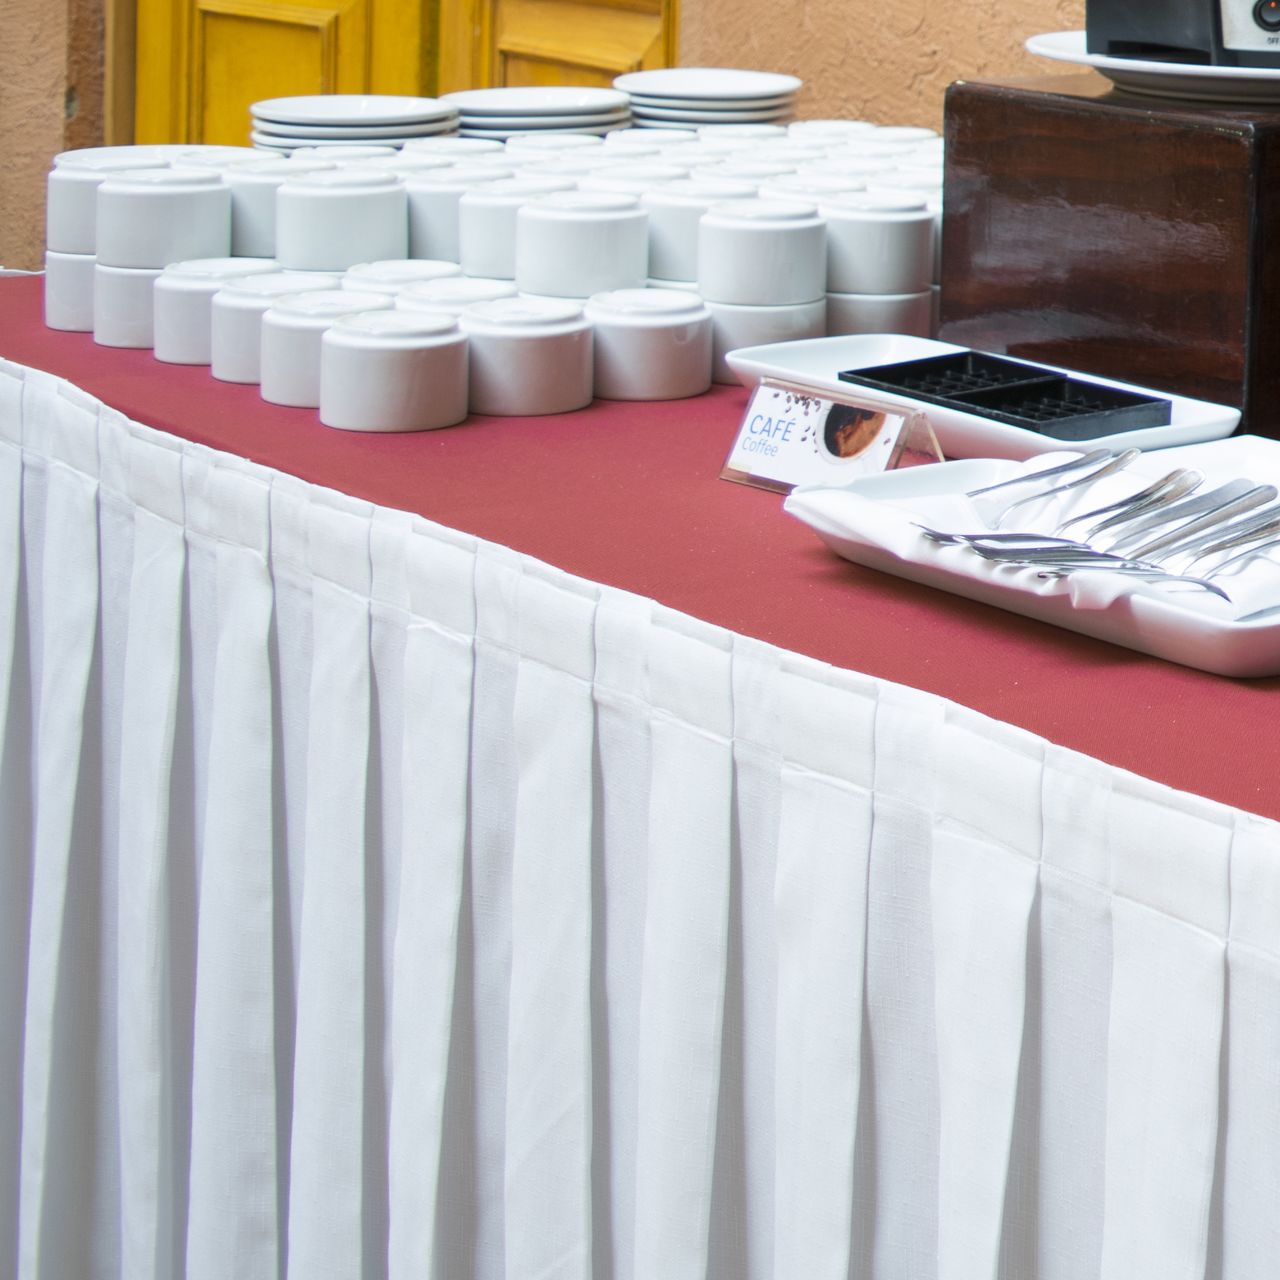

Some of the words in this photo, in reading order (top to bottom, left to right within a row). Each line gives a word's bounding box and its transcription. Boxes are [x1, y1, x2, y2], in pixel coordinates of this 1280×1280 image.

[1267, 36, 1279, 45] OFF
[749, 413, 796, 443] CAFÉ
[741, 435, 779, 458] Coffee
